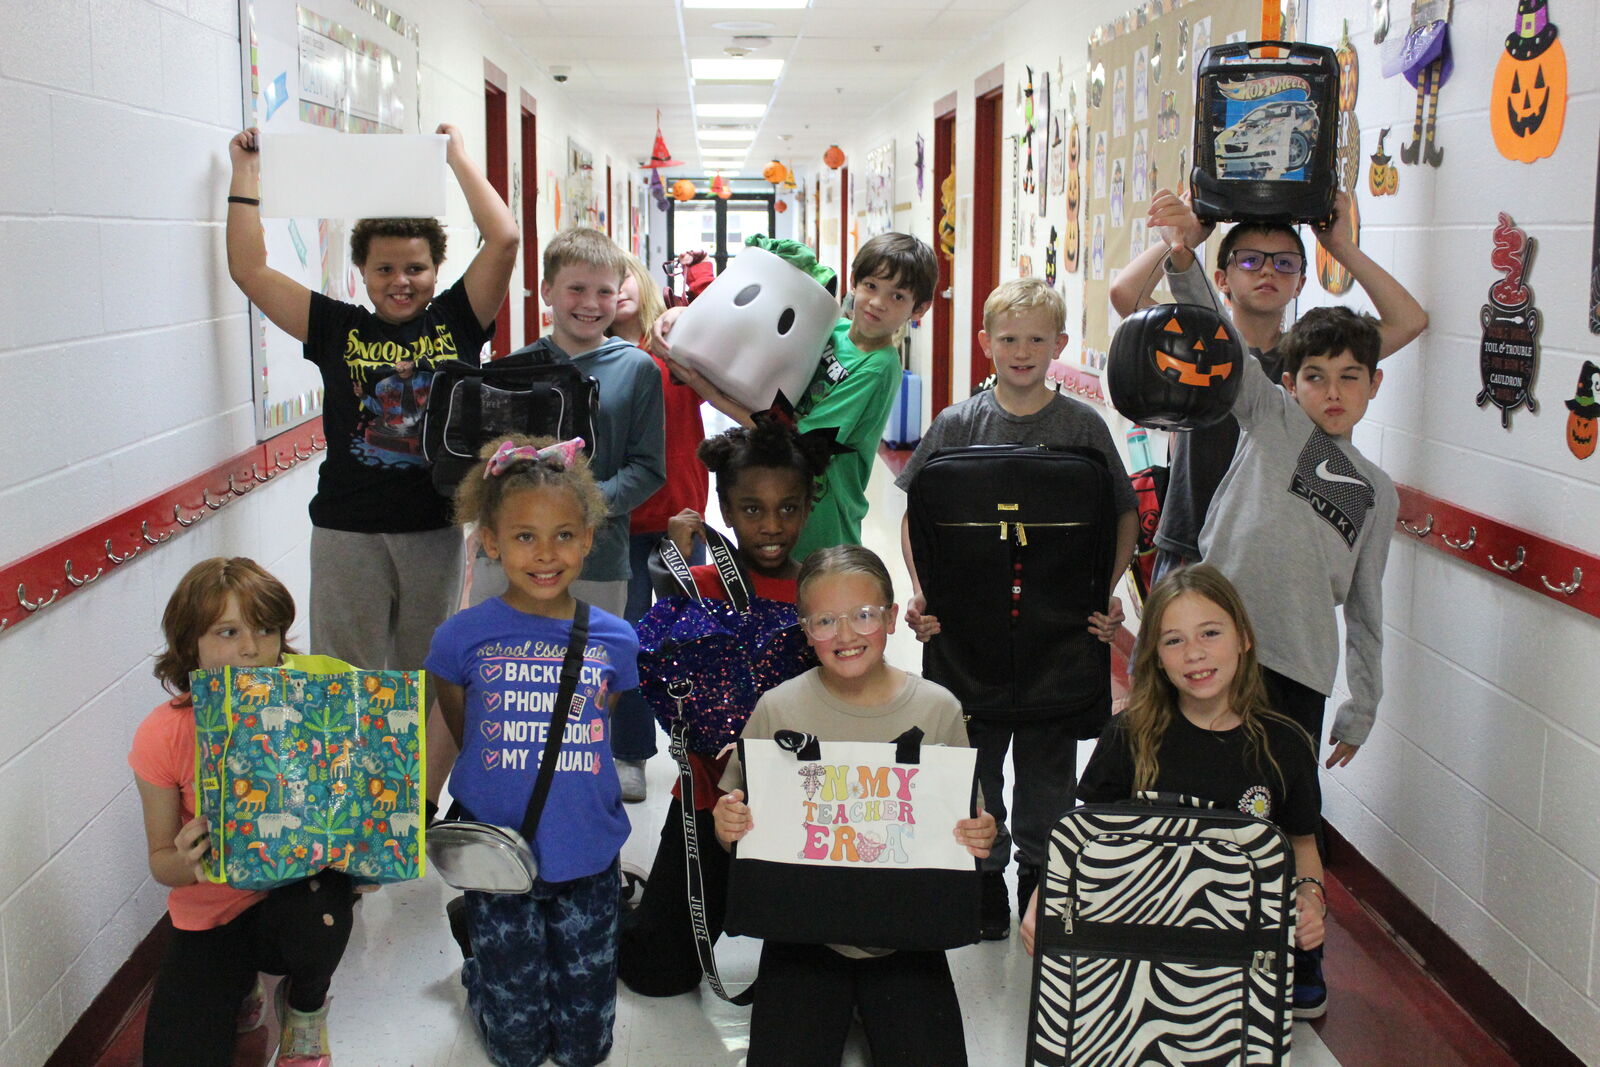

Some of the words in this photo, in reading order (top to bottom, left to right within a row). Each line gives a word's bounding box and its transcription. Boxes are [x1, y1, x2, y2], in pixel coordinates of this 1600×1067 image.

[344, 328, 411, 363] SNOOP
[1484, 342, 1498, 352] TOIL
[1499, 341, 1505, 353] &
[1505, 344, 1532, 357] TROUBLE
[1490, 373, 1523, 387] CAULDRON
[1311, 496, 1356, 544] NIKE
[663, 546, 692, 581] JUSTICE
[712, 545, 738, 585] JUSTICE
[533, 640, 609, 658] Esseials
[505, 662, 602, 687] BACKCK
[503, 721, 591, 745] NOTEOOK
[502, 748, 530, 770] MY
[856, 765, 919, 801] MY
[803, 800, 916, 825] TEACHER
[685, 811, 698, 862] JUSTICE
[803, 823, 909, 864] ERA
[691, 896, 708, 942] JUSTICE
